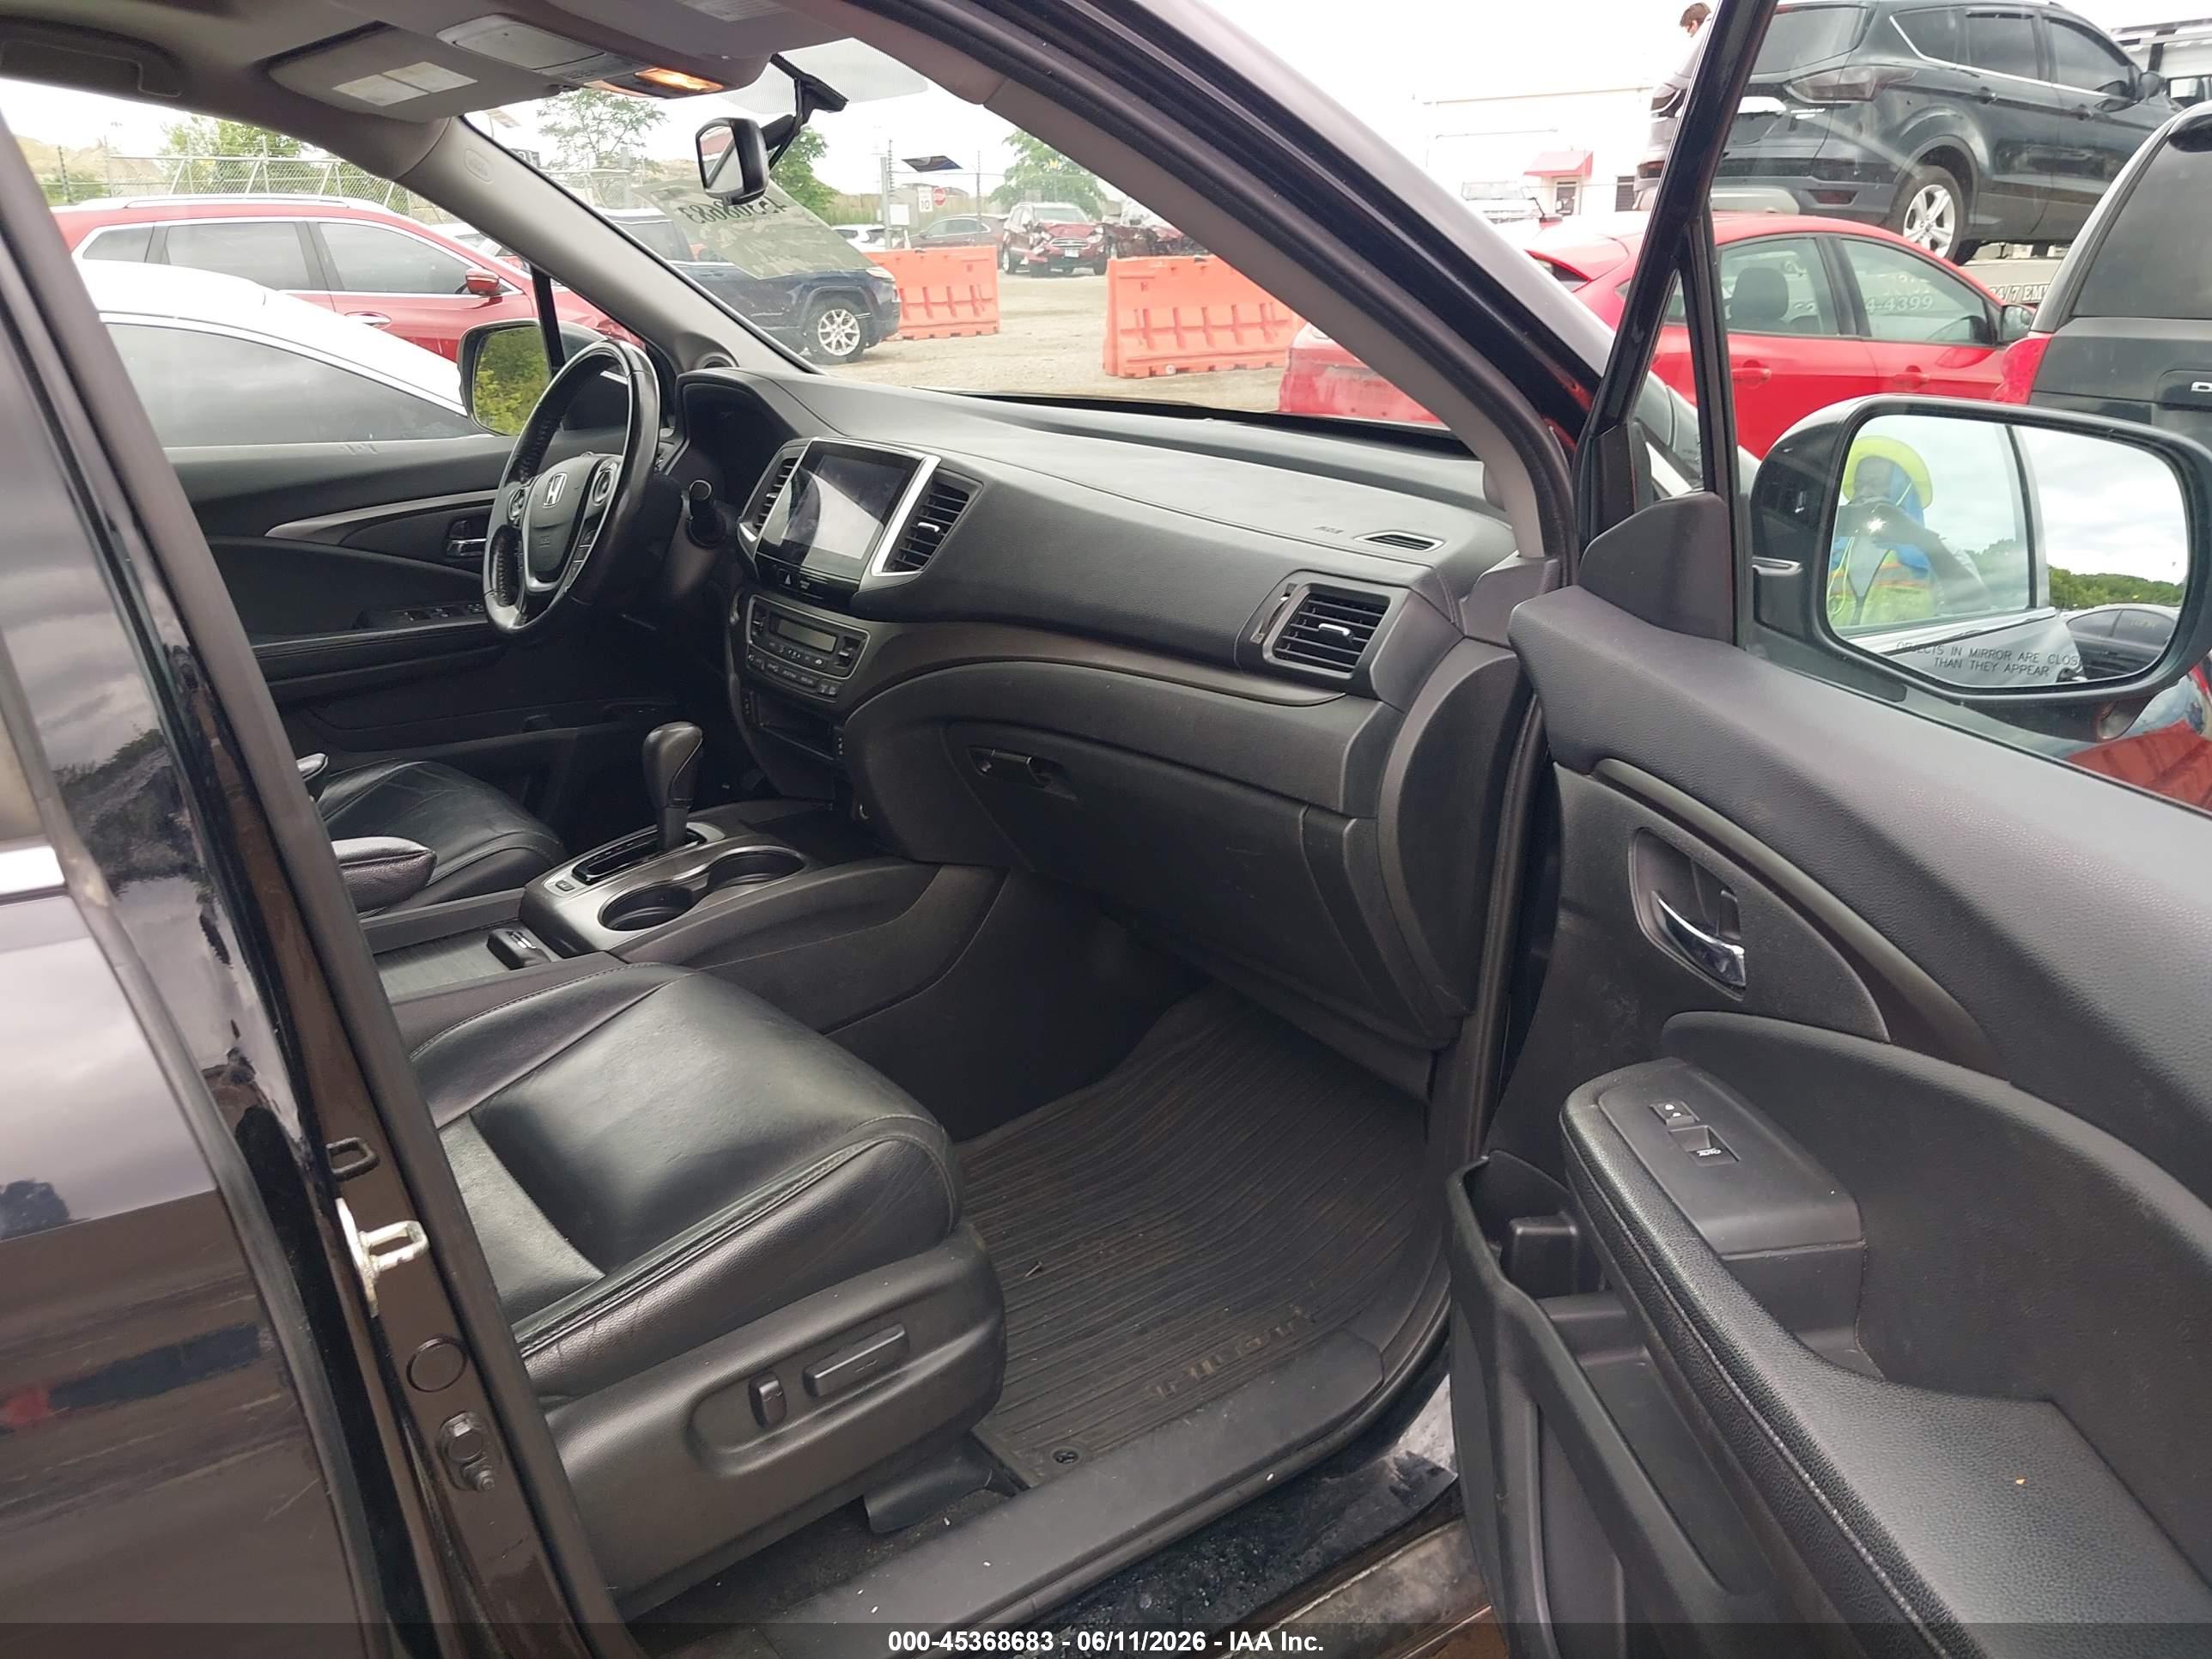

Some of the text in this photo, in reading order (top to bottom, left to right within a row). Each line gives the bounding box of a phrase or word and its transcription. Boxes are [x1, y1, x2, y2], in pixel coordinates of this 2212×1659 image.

[1951, 645, 1963, 657] IN
[1969, 647, 2012, 661] MIRROR
[2017, 651, 2040, 664] ARE
[1934, 657, 2050, 677] THAN THEY APPEAR
